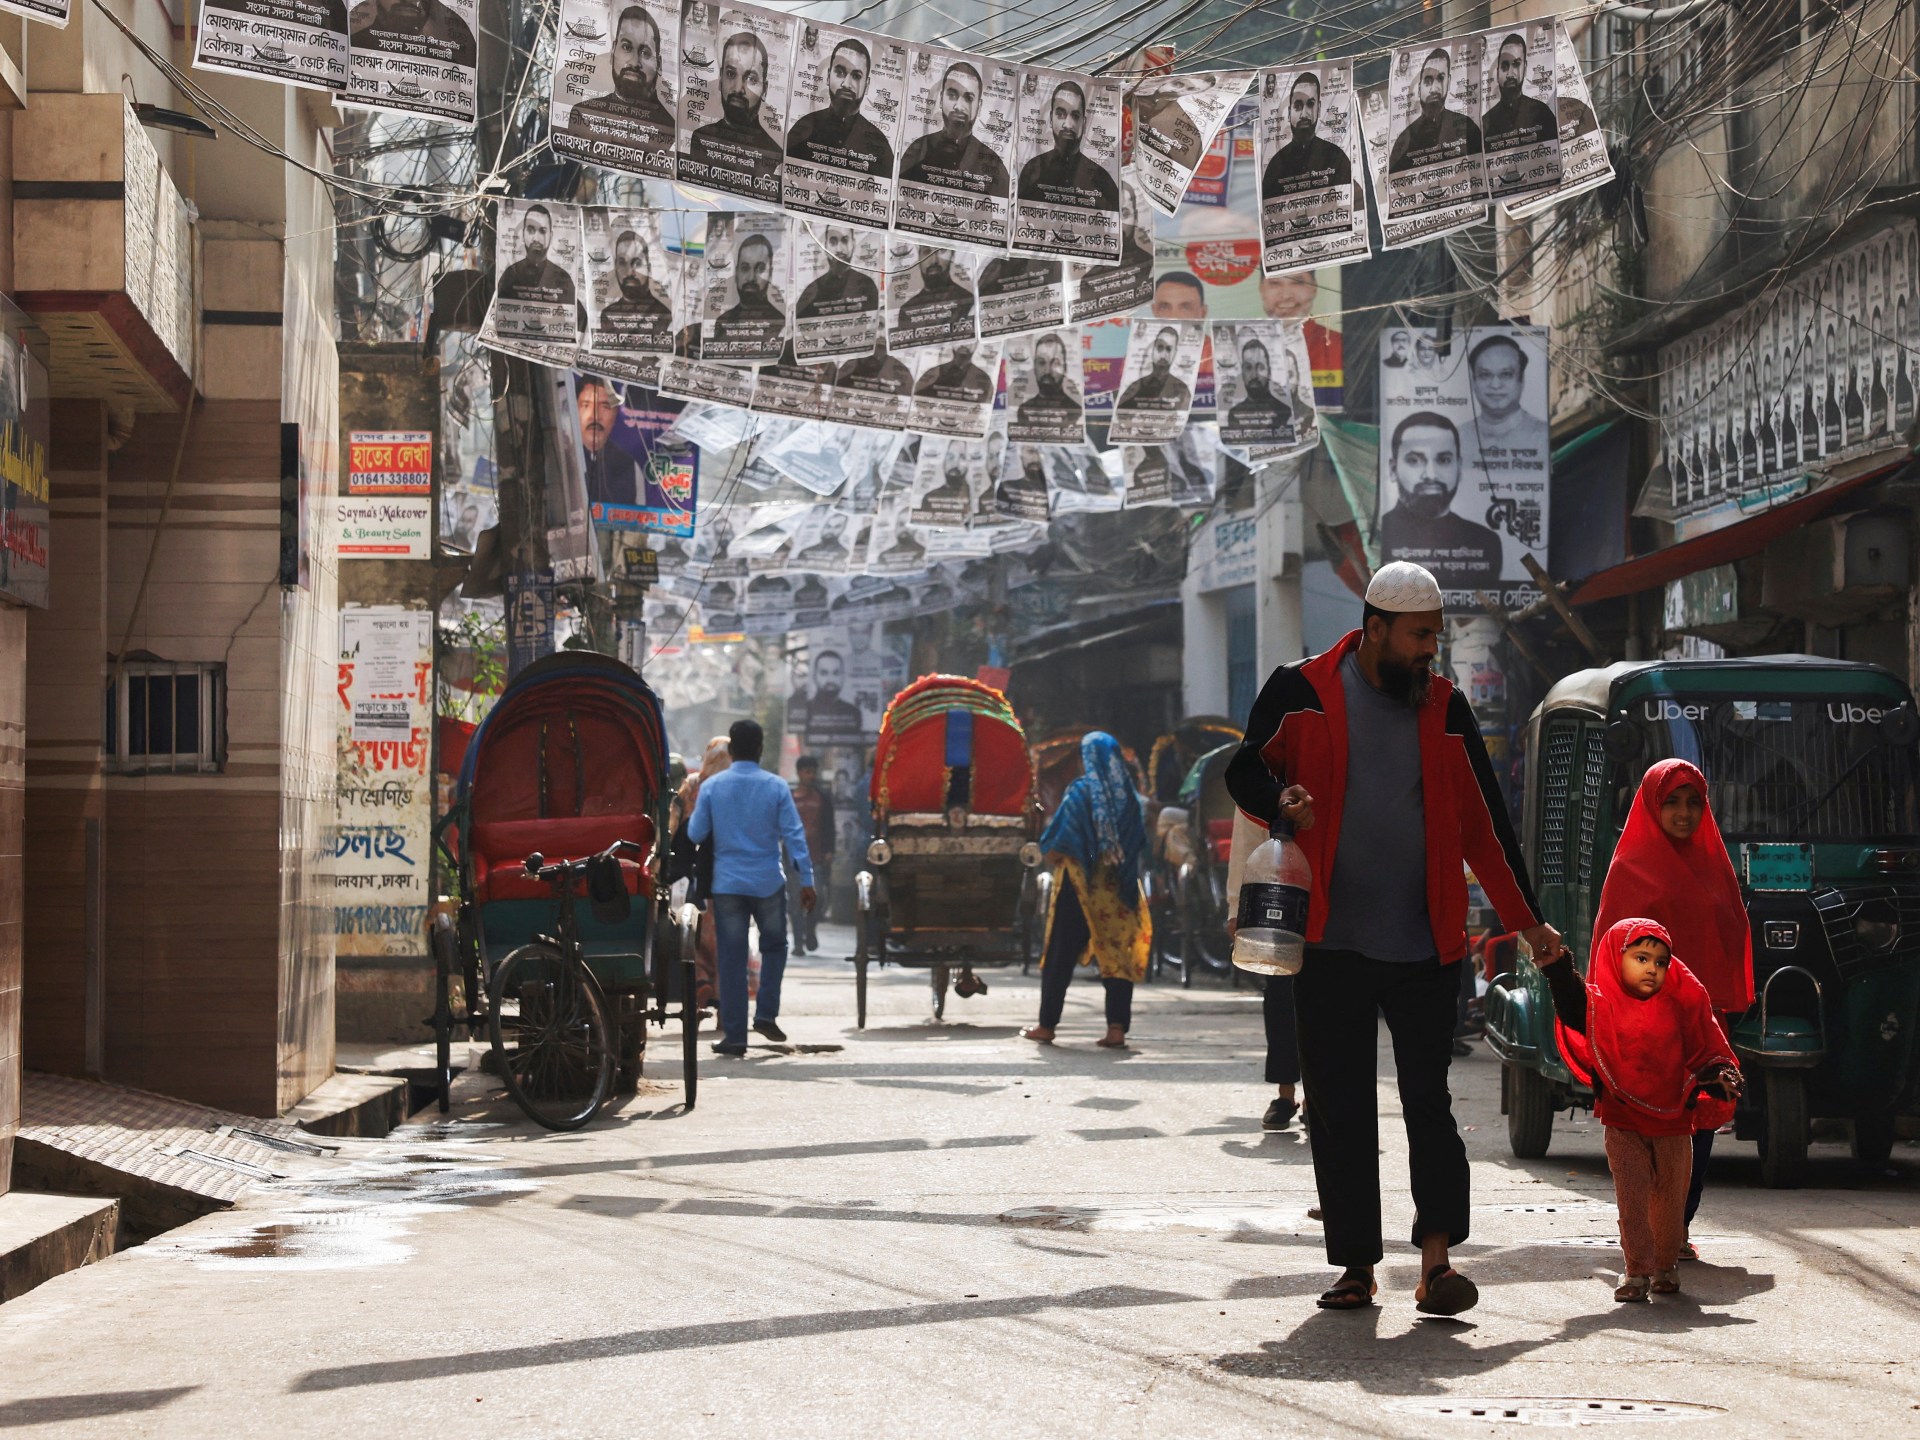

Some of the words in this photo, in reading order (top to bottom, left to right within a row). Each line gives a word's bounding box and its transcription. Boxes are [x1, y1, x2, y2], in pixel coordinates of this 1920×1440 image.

[246, 2, 269, 15] সংসদ
[272, 6, 294, 19] সদস্য
[206, 14, 249, 33] মোহাম্মদ
[252, 23, 306, 43] সোলায়মান
[309, 32, 338, 50] সেলিম
[204, 33, 243, 56] নৌকায়
[301, 56, 324, 68] ভোট
[327, 58, 344, 74] দিন
[379, 39, 403, 50] সংসদ
[405, 44, 427, 55] সদস্য
[569, 46, 596, 61] নৌকা
[385, 59, 439, 78] সোলায়মান
[442, 67, 467, 85] সেলিম
[565, 60, 596, 74] মার্কায়
[566, 74, 590, 85] ভোট
[688, 73, 707, 88] নৌকা
[435, 90, 456, 102] ভোট
[458, 91, 472, 108] দিন
[566, 83, 583, 97] দিন
[687, 100, 705, 112] ভোট
[553, 133, 591, 152] মোহাম্মদ
[593, 141, 644, 164] সোলায়মান
[645, 150, 674, 169] সেলিম
[1570, 138, 1594, 156] সেলিম
[1153, 157, 1179, 179] সেলিম
[1572, 162, 1588, 176] ভোট
[1590, 154, 1605, 168] দিন
[679, 158, 709, 177] মোহাম্মদ
[711, 169, 752, 189] সোলায়মান
[754, 174, 779, 193] সেলিম
[816, 170, 856, 189] সোলায়মান
[858, 177, 881, 195] সেলিম
[851, 199, 869, 211] ভোট
[872, 202, 886, 217] দিন
[931, 192, 972, 209] সোলায়মান
[975, 198, 999, 214] সেলিম
[899, 202, 926, 223] নৌকায়
[1019, 206, 1048, 221] মোহাম্মদ
[1050, 210, 1087, 226] সোলায়মান
[1088, 213, 1110, 228] সেলিম
[1018, 222, 1045, 242] নৌকায়
[352, 445, 393, 471] হাতের
[398, 444, 428, 468] লেখা
[353, 474, 428, 484] 01641-336802
[338, 505, 377, 524] Sayma's
[379, 506, 428, 522] Makeover
[343, 528, 352, 538] &
[356, 528, 391, 540] Beauty
[393, 528, 421, 539] Salon
[358, 702, 388, 712] পড়াতে
[392, 701, 407, 712] চাই
[1644, 700, 1709, 721] Uber
[1771, 930, 1793, 942] RE
